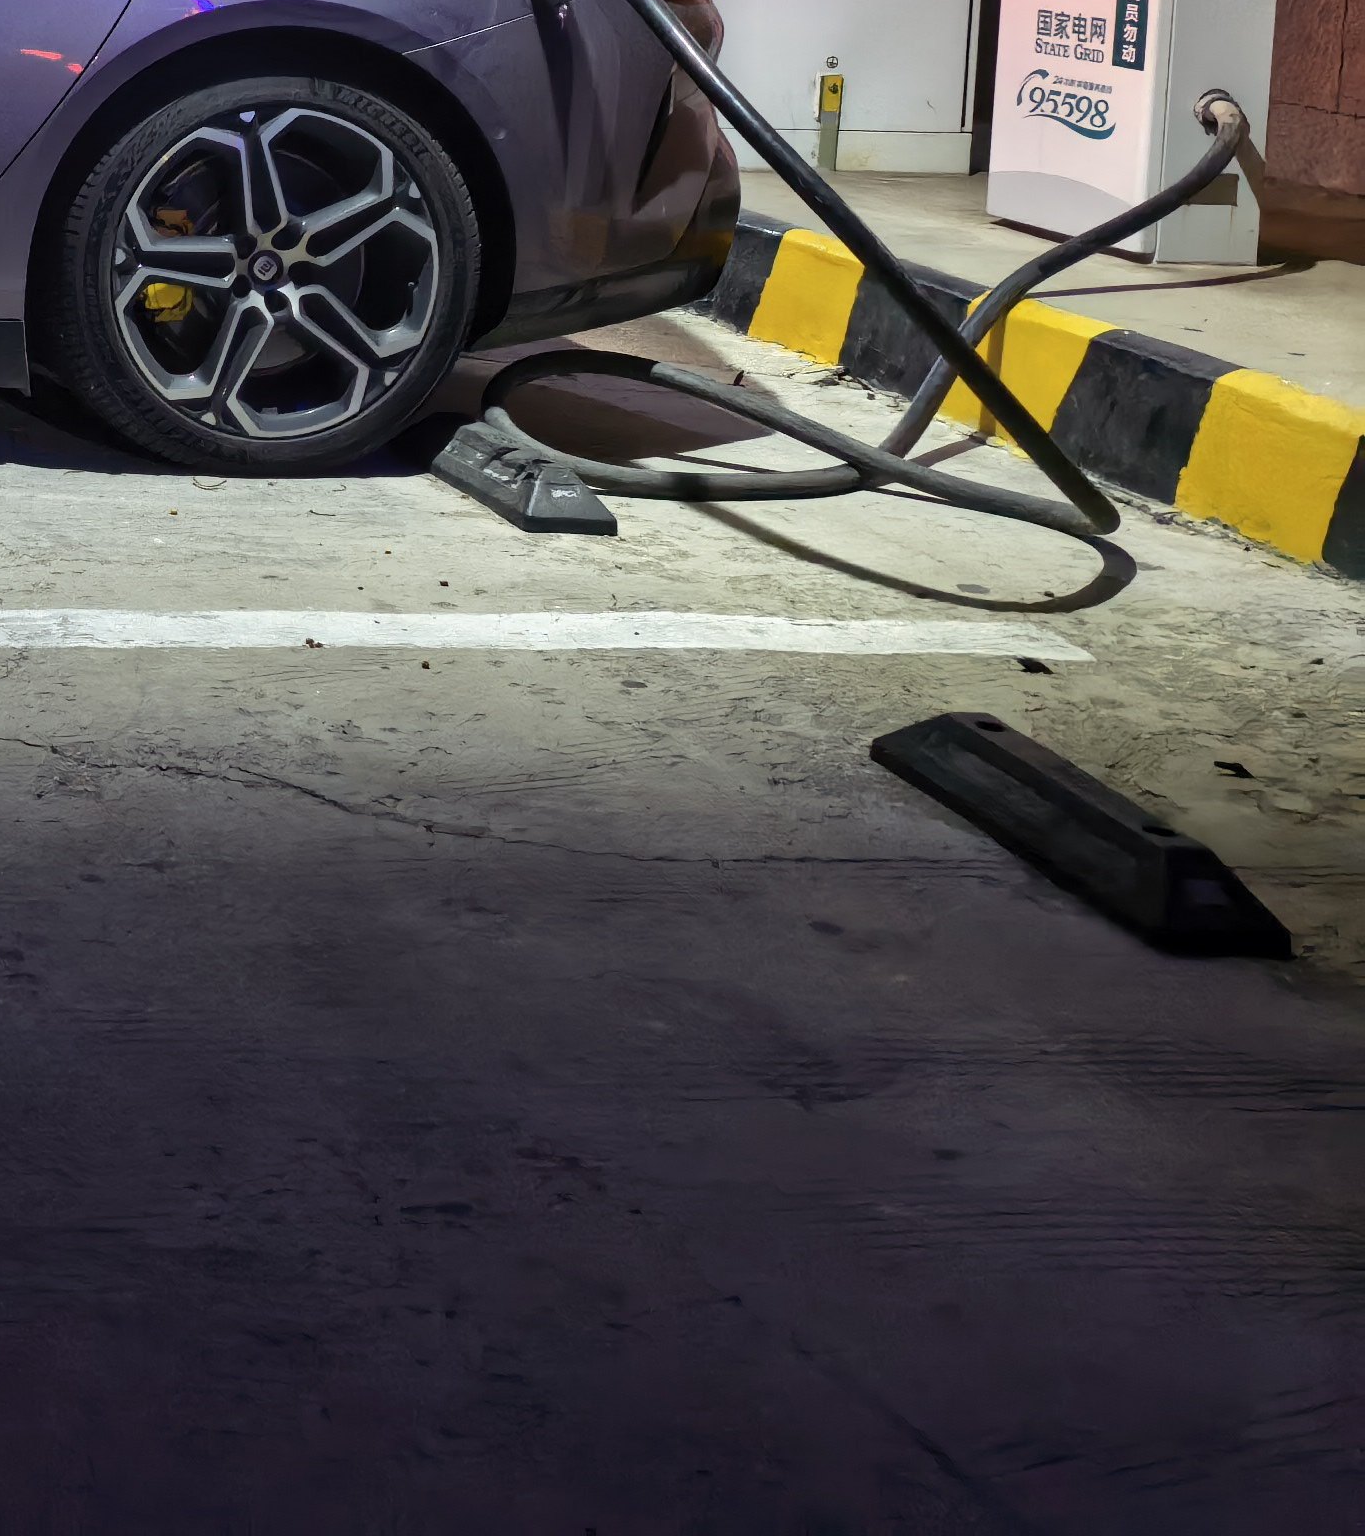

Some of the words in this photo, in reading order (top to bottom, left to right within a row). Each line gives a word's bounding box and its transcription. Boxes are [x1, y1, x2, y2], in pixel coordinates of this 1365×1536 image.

[1036, 9, 1107, 45] 国家电网
[1034, 37, 1070, 58] STATE
[1073, 43, 1105, 64] GRID
[1029, 86, 1110, 128] 95598
